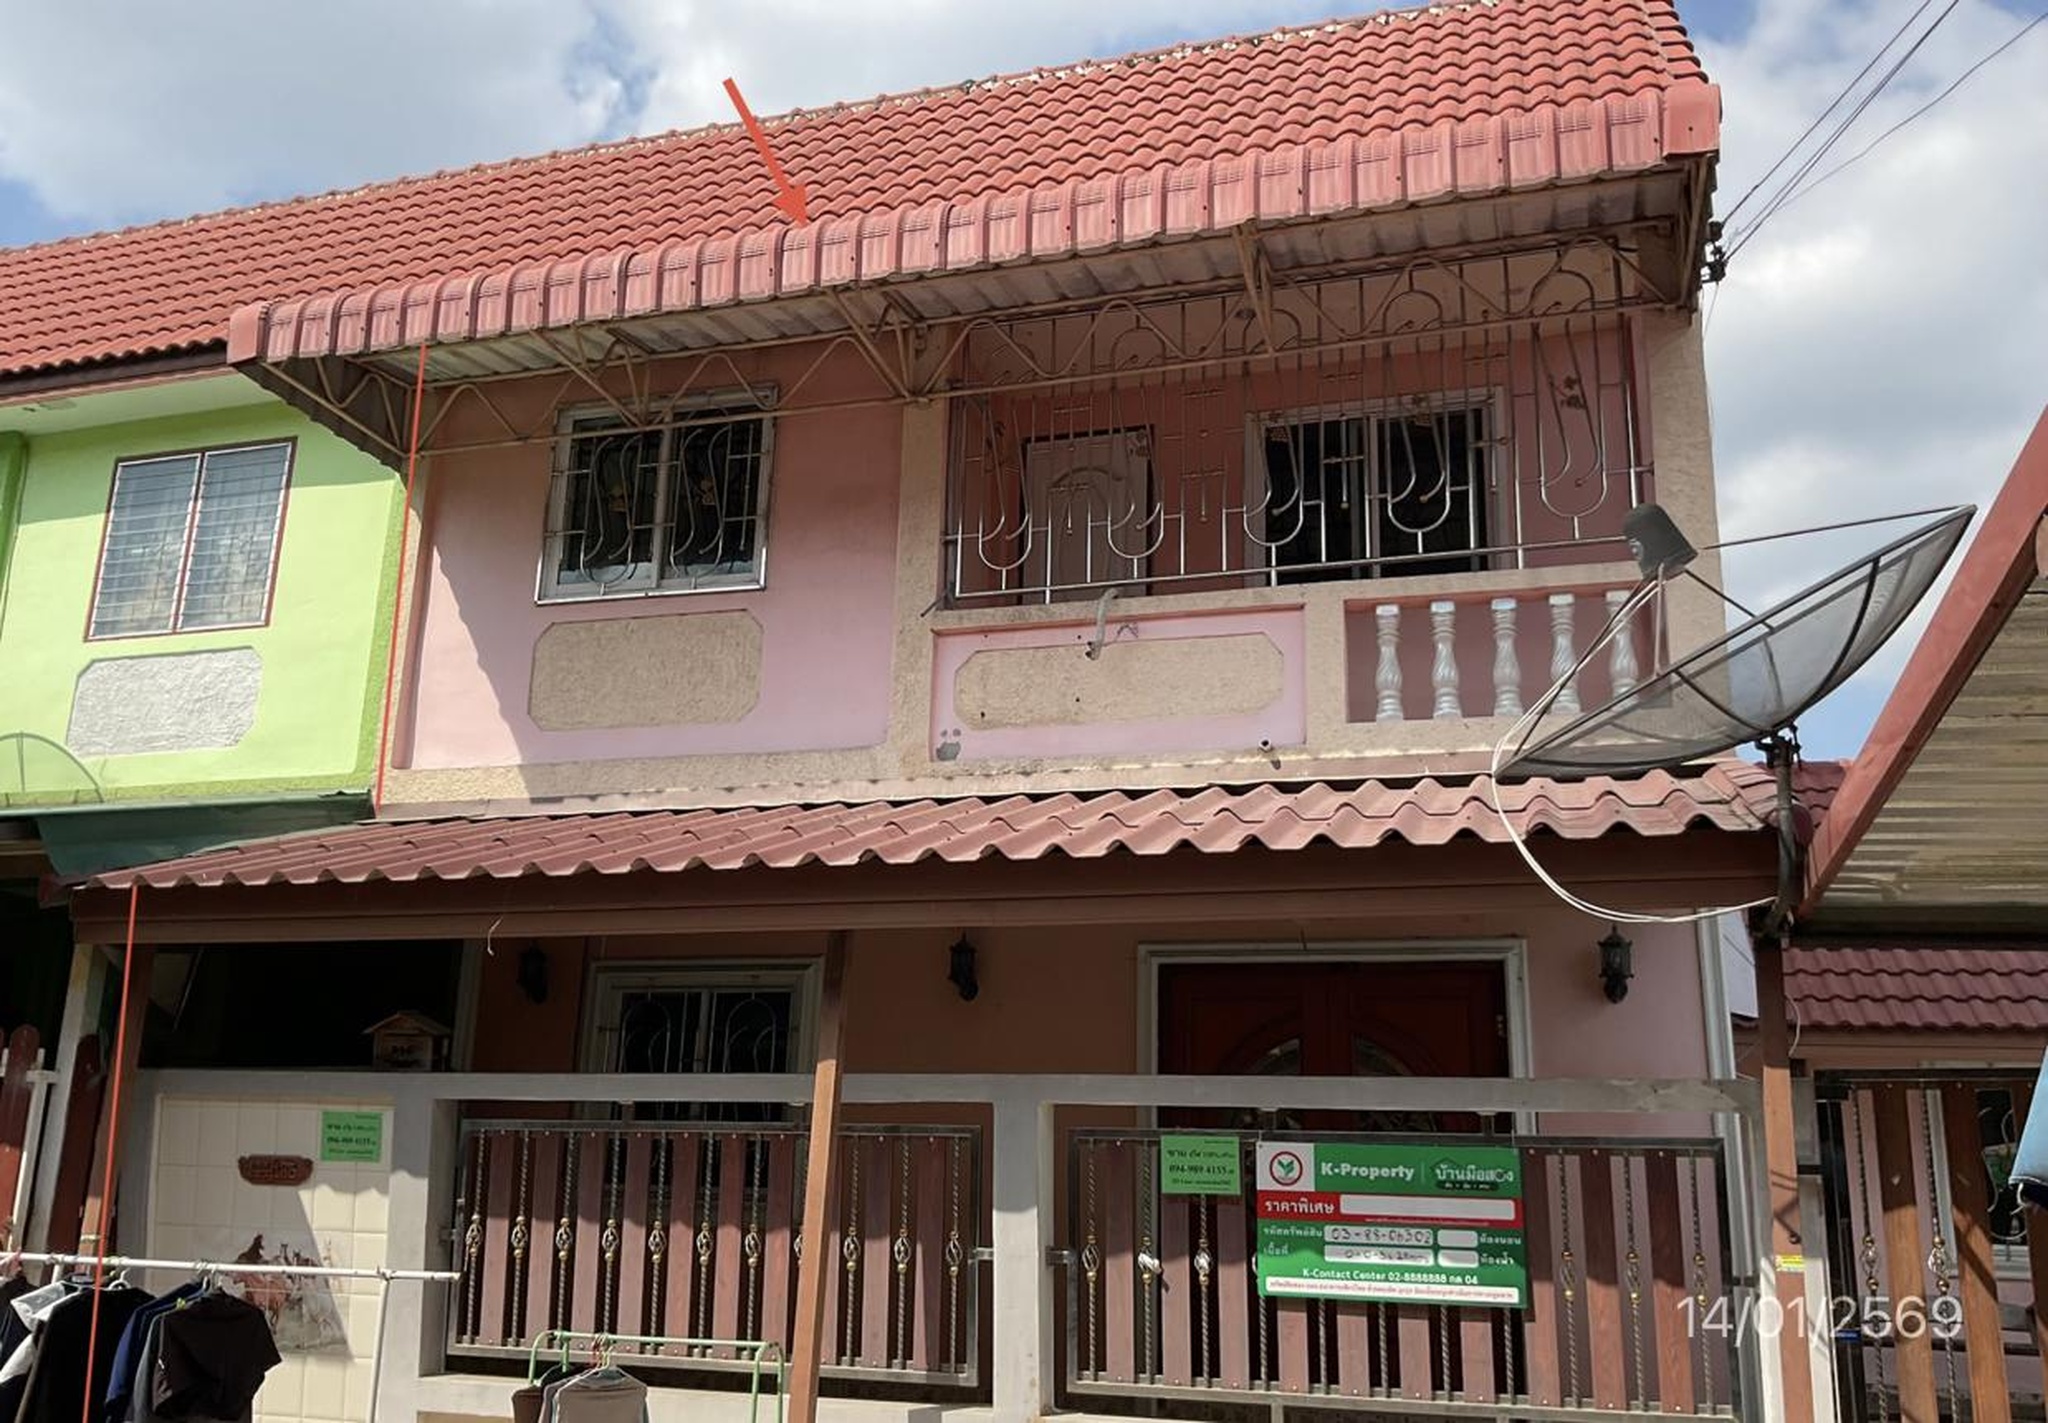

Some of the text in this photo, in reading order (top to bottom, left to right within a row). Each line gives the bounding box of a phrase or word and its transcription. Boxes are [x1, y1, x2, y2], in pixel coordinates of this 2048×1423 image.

[1321, 1161, 1415, 1181] K-Property
[1435, 1163, 1514, 1183] บ้านมือสอง
[1264, 1196, 1334, 1214] ราคาพิเศษ
[1302, 1267, 1351, 1279] K-Contact
[1352, 1270, 1386, 1280] Center
[1387, 1271, 1447, 1284] 02-8888888
[1464, 1275, 1478, 1285] 04
